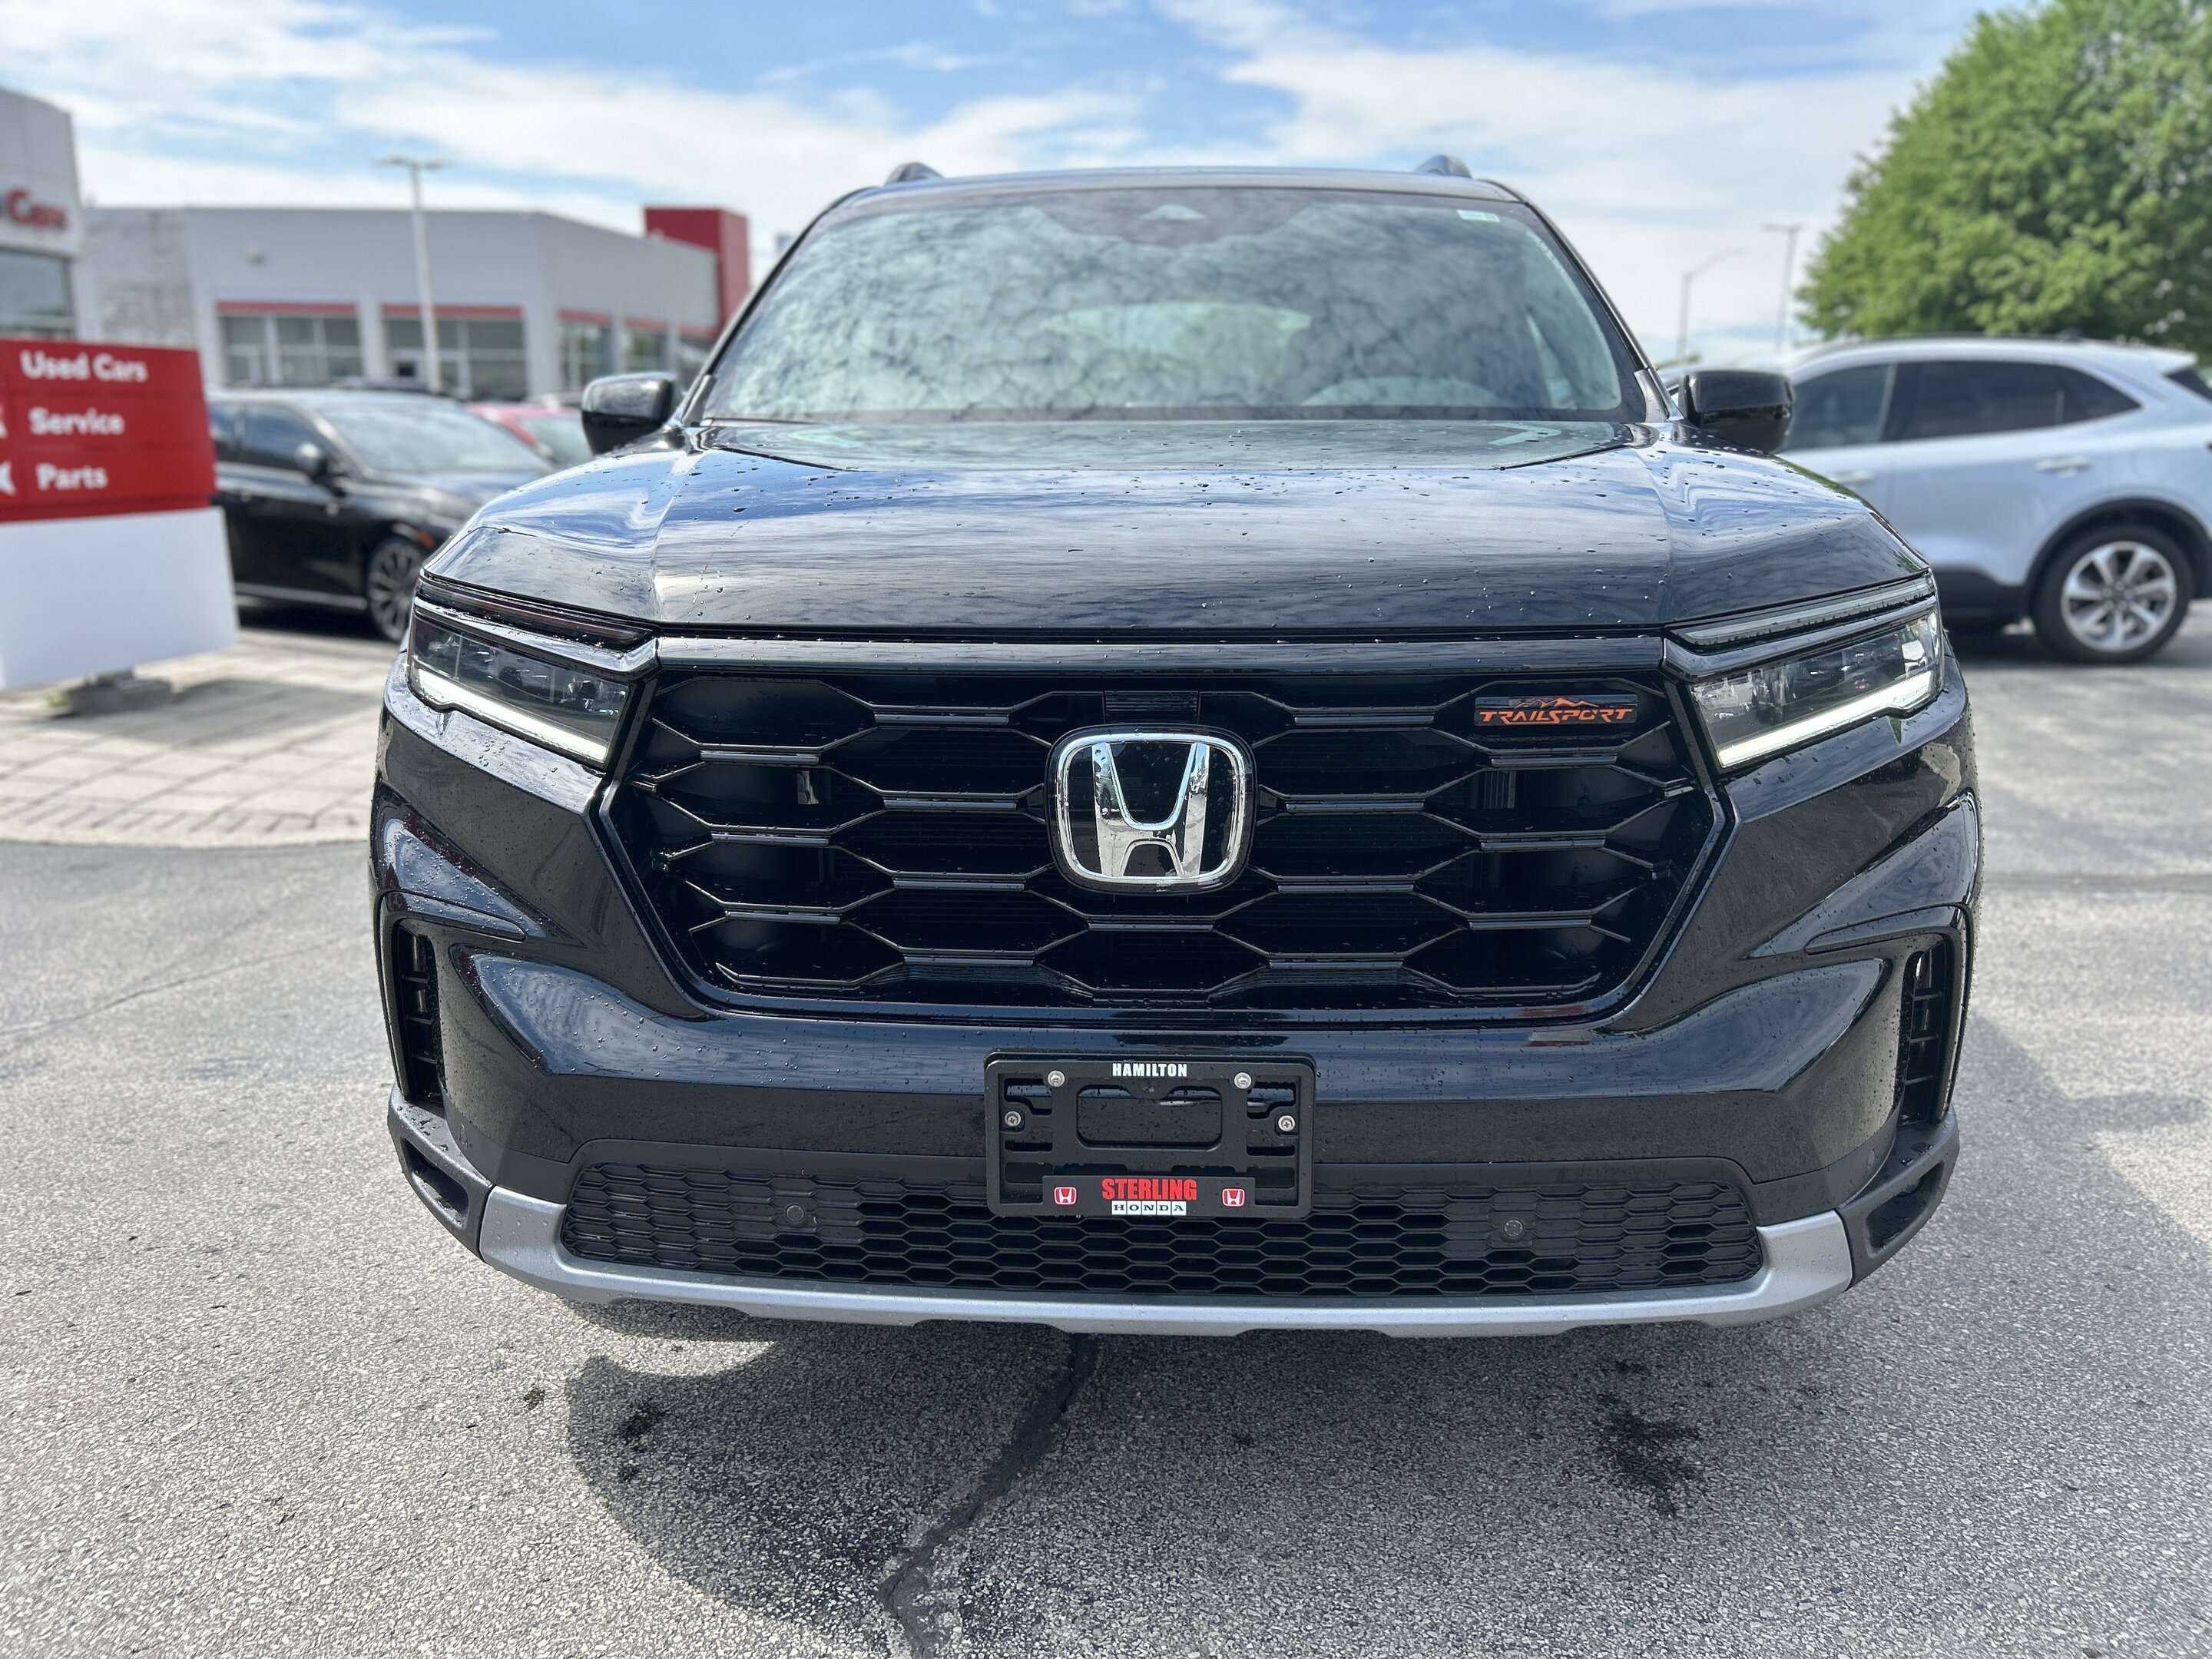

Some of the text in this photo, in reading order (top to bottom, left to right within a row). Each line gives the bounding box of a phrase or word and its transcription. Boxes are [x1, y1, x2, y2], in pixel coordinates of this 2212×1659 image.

[21, 350, 148, 382] Used Cars
[28, 407, 124, 435] Service
[35, 463, 108, 491] Parts
[1479, 708, 1633, 725] TRAILSPORT
[1112, 1062, 1188, 1077] HAMILTON
[1102, 1178, 1197, 1200] STERLING
[1112, 1203, 1186, 1214] HONDA
